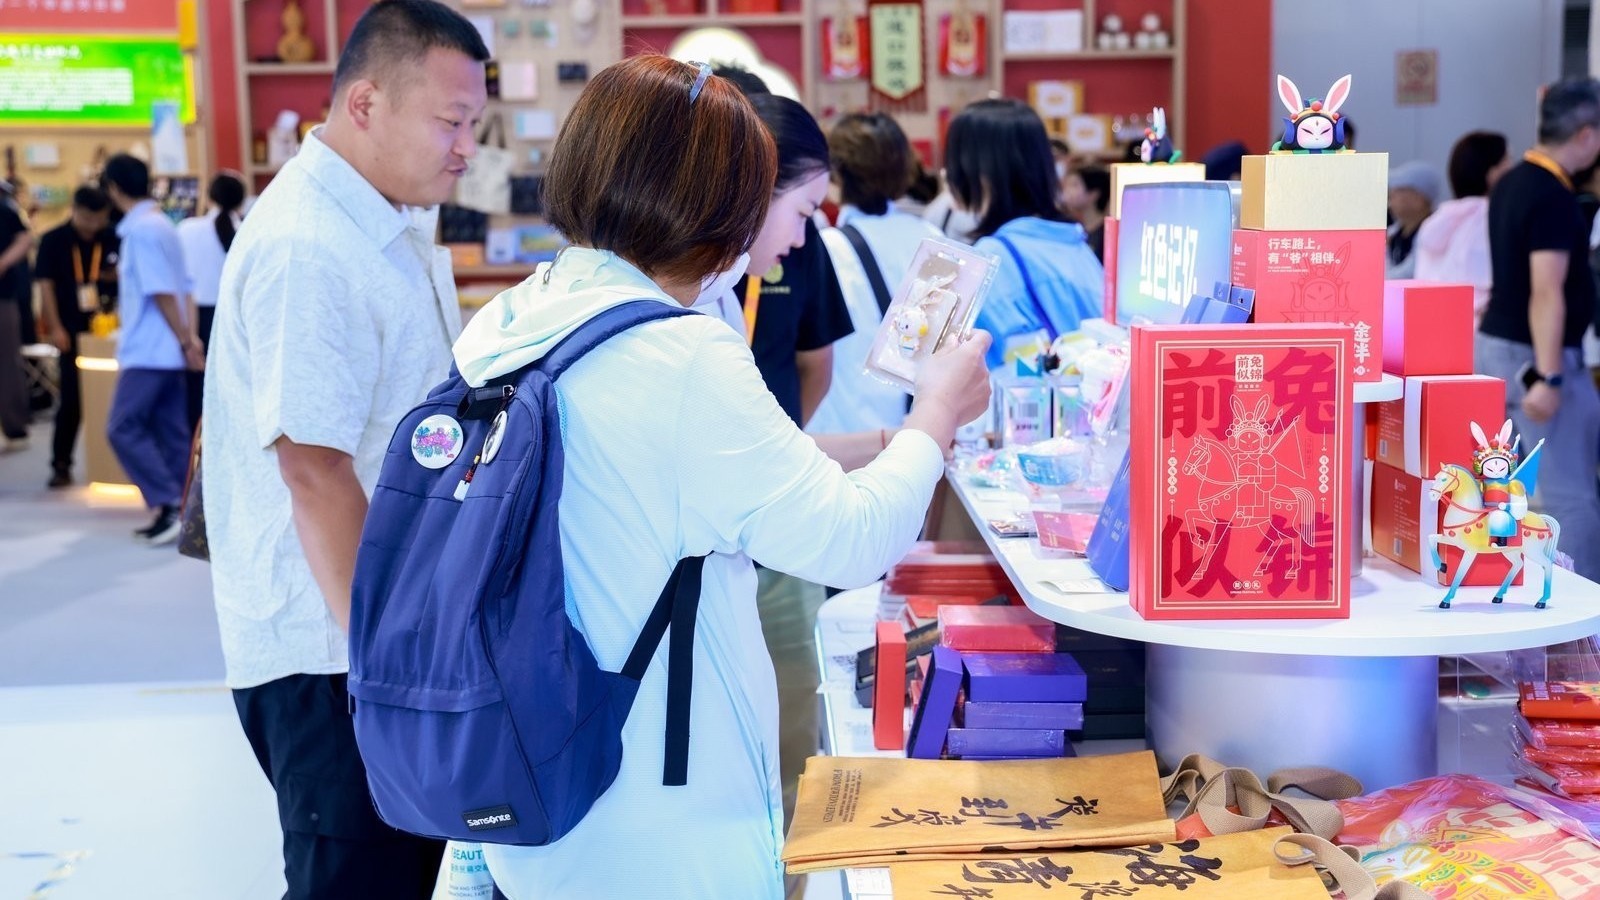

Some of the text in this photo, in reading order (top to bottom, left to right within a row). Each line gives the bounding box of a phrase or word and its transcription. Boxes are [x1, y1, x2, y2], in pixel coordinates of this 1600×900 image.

[1267, 238, 1321, 250] 行车路上，
[1139, 221, 1199, 308] 红色记忆
[467, 813, 511, 827] Samsonite
